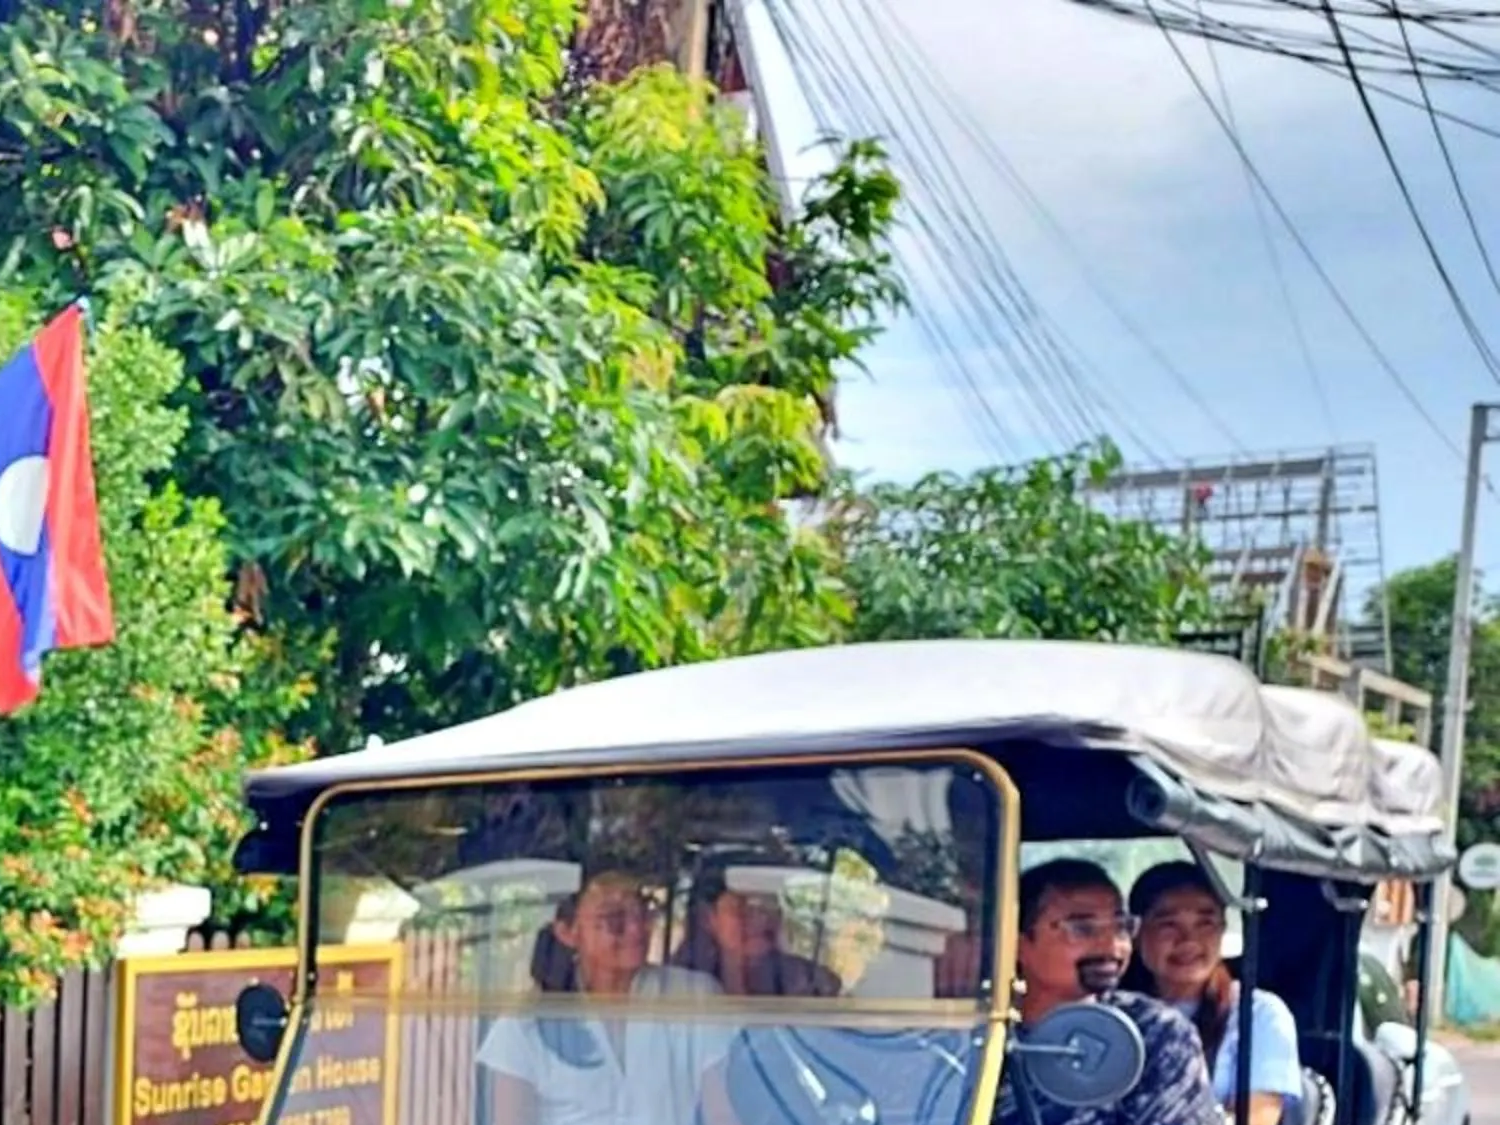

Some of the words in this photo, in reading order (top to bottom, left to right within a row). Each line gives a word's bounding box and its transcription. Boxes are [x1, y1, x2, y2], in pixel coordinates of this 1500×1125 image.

[133, 1071, 227, 1117] Sunrise
[231, 1064, 312, 1104] Garen
[316, 1055, 381, 1090] House
